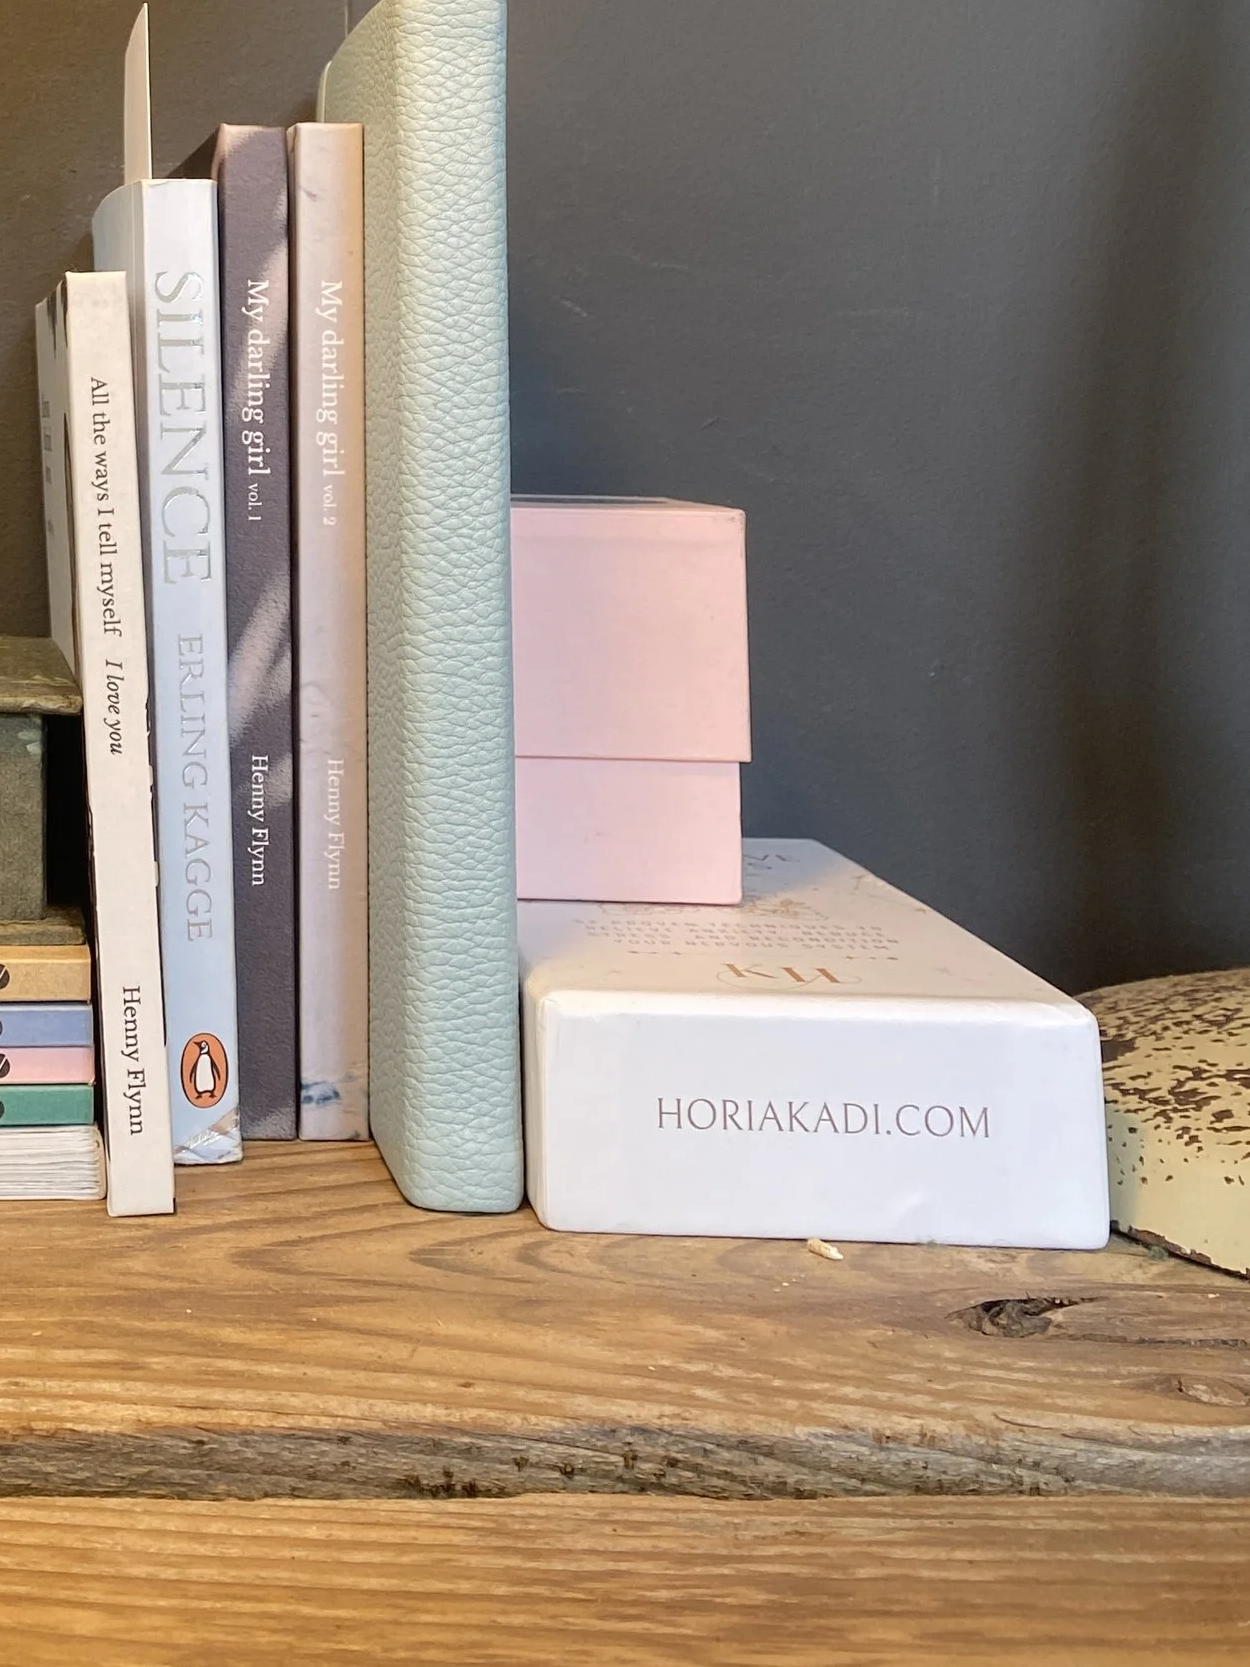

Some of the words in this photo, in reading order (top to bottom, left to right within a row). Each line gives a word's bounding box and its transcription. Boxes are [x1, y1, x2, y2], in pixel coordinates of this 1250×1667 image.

[240, 279, 270, 322] My
[314, 279, 343, 323] My
[90, 376, 110, 406] All
[241, 328, 271, 424] darling
[315, 329, 345, 425] darling
[92, 412, 111, 445] the
[154, 271, 212, 584] SILENCE
[90, 450, 110, 502] ways
[241, 429, 271, 476] girl
[315, 430, 346, 477] girl
[97, 508, 115, 517] I
[247, 482, 263, 511] vol.
[322, 484, 337, 513] vol.
[98, 523, 118, 556] tell
[322, 516, 336, 526] 2
[97, 563, 122, 637] myself
[105, 659, 123, 670] I
[106, 675, 125, 715] love
[177, 633, 208, 790] ERLING
[103, 717, 123, 756] you
[247, 754, 269, 823] Henny
[324, 758, 345, 825] Henny
[183, 800, 213, 942] KAGGE
[247, 827, 270, 886] Flynn
[324, 830, 346, 890] Flynn
[120, 985, 142, 1063] Henny
[122, 1068, 147, 1136] Flynn
[656, 1097, 991, 1138] HORIAKADI.COM
